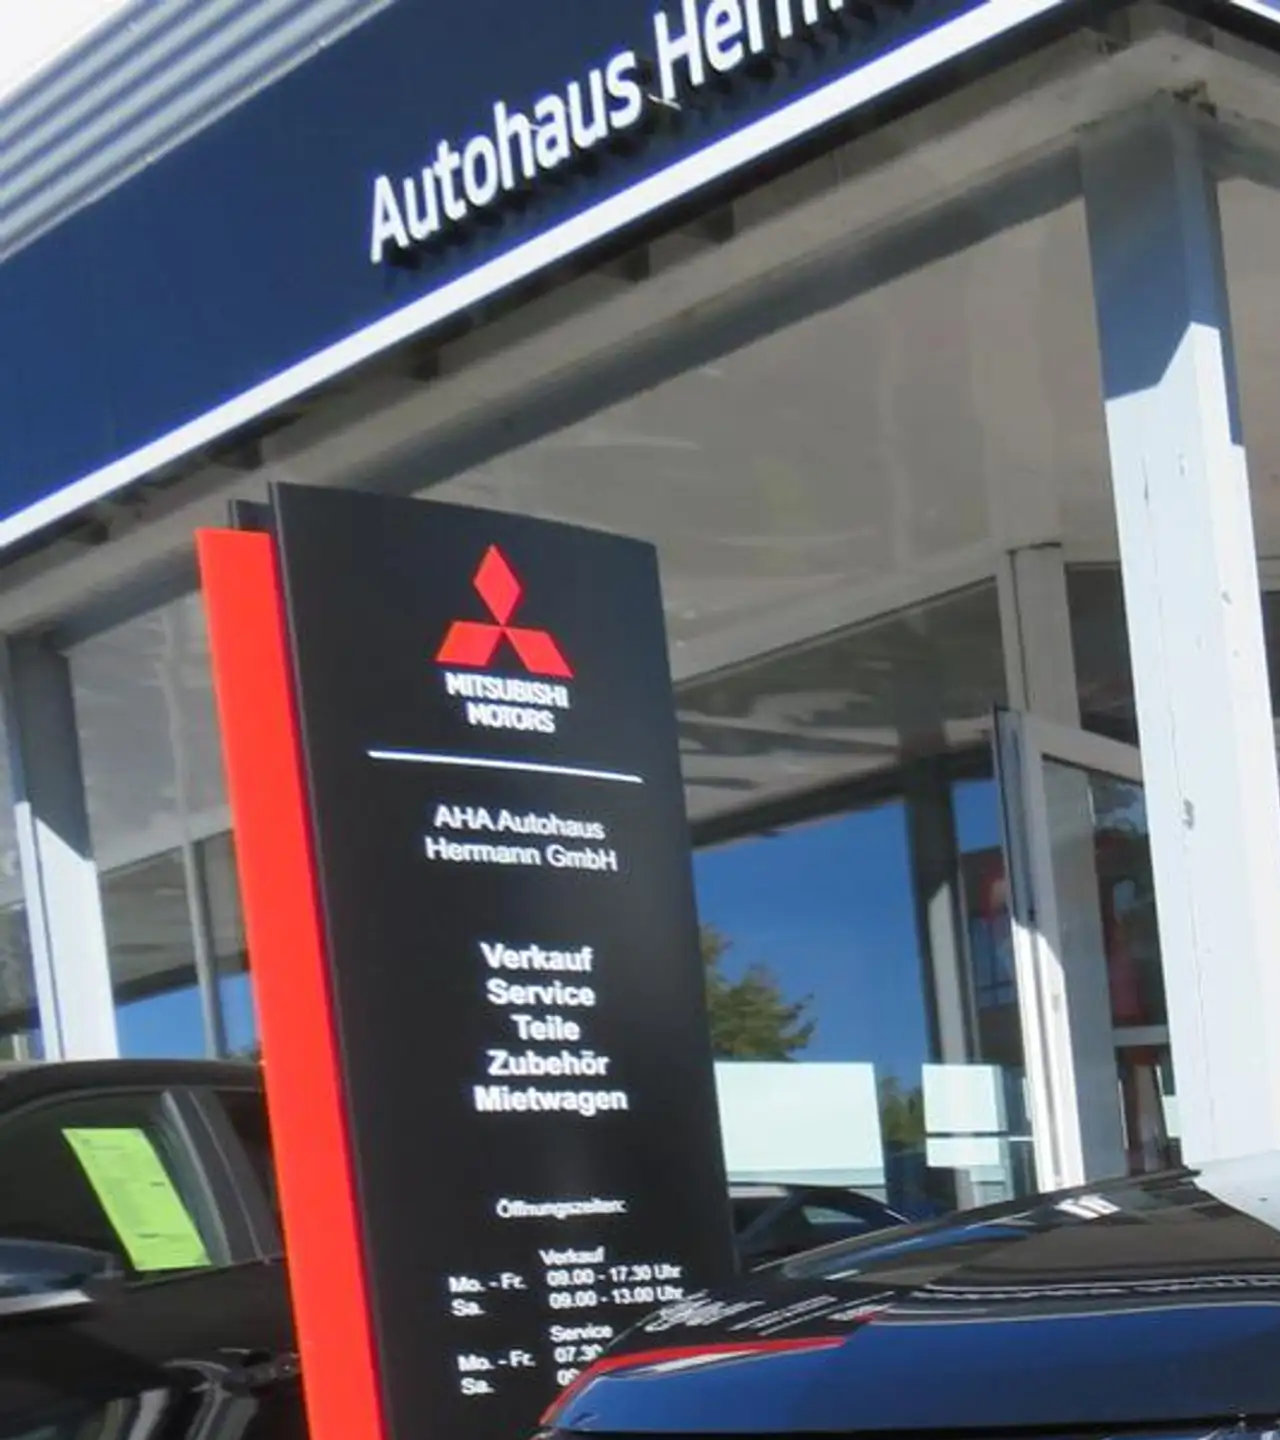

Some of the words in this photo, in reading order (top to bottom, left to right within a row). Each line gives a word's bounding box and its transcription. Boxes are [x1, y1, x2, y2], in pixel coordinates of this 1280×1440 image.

[369, 46, 642, 264] Autohaus
[445, 672, 569, 708] MITSUBISHI
[466, 704, 555, 733] MOTORS
[433, 804, 493, 832] AHA
[499, 808, 606, 840] Autohaus
[425, 836, 541, 867] Hermann
[547, 843, 618, 872] GmbH
[480, 941, 593, 972] Verkauf
[486, 979, 596, 1007] Service
[511, 1014, 581, 1043] Teile
[486, 1049, 610, 1078] Zubehör
[473, 1085, 629, 1117] Mietwagen
[538, 1245, 604, 1266] Verkauf
[549, 1325, 613, 1343] Service
